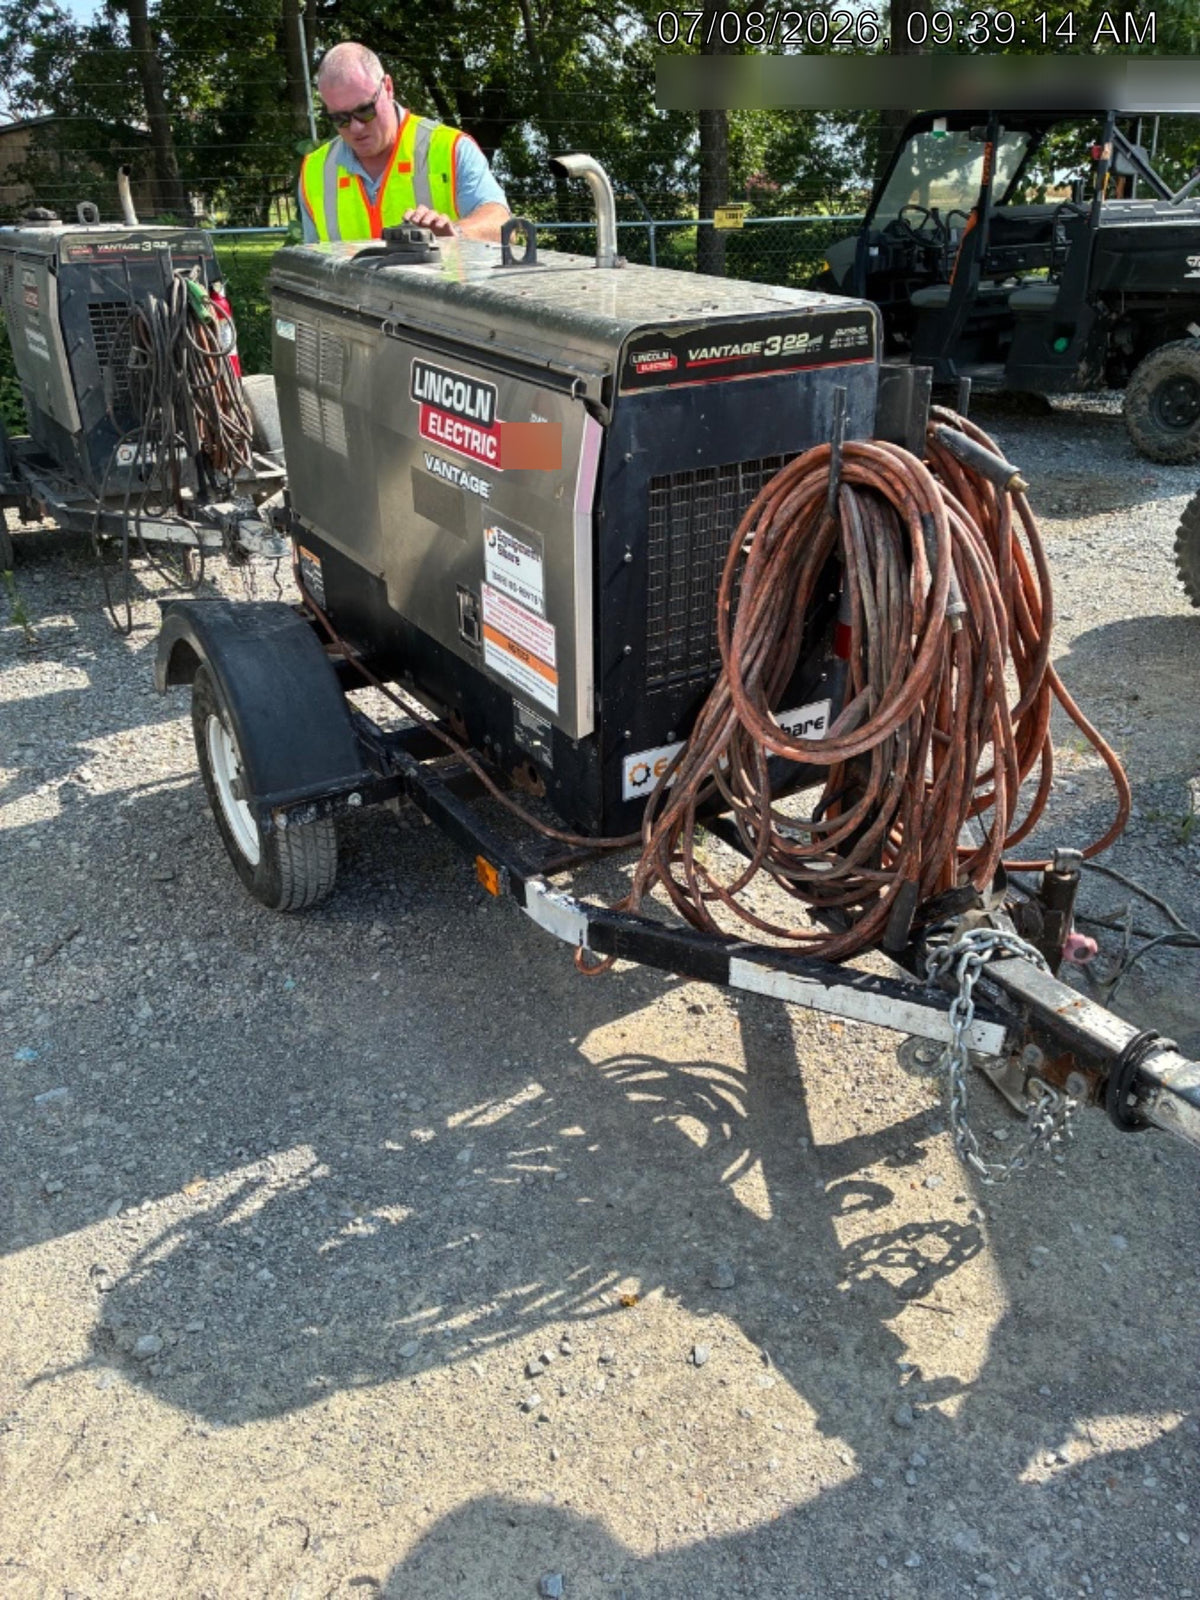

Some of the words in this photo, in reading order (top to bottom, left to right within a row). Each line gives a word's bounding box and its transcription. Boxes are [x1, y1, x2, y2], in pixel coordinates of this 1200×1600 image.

[97, 243, 141, 252] VANTAGE
[632, 351, 670, 364] LINCOLN
[688, 340, 765, 361] VANTAGE
[763, 332, 810, 357] 322
[413, 366, 492, 423] LINCOLN
[427, 411, 498, 460] ELECTRIC
[423, 451, 493, 499] VANTAGE
